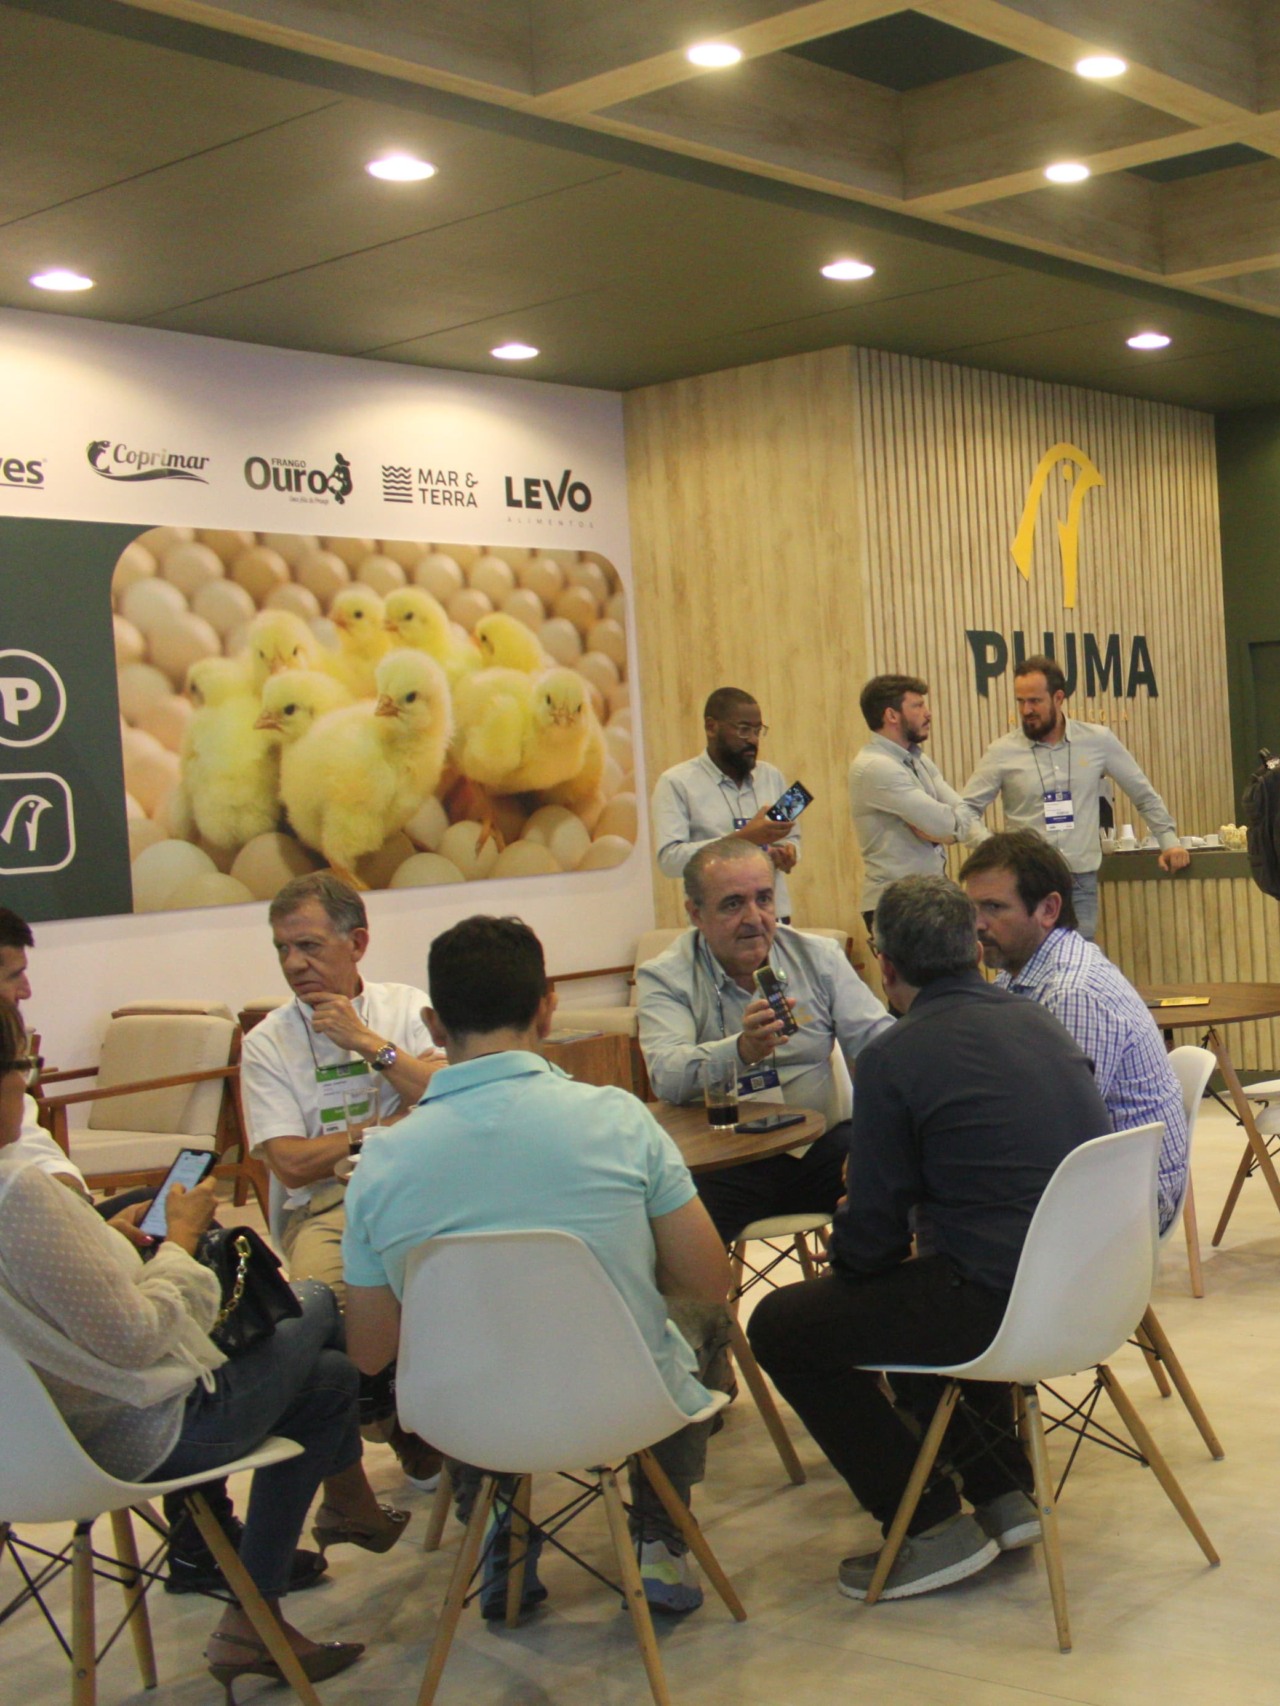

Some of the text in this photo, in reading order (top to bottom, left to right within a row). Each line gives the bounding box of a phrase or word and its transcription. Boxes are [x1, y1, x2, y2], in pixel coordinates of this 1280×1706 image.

[113, 443, 210, 471] Coprimar
[271, 457, 307, 469] FRANGO
[244, 456, 329, 495] Ouro
[418, 468, 479, 489] MAR &
[418, 488, 479, 508] TERRA
[505, 469, 593, 513] LEVO
